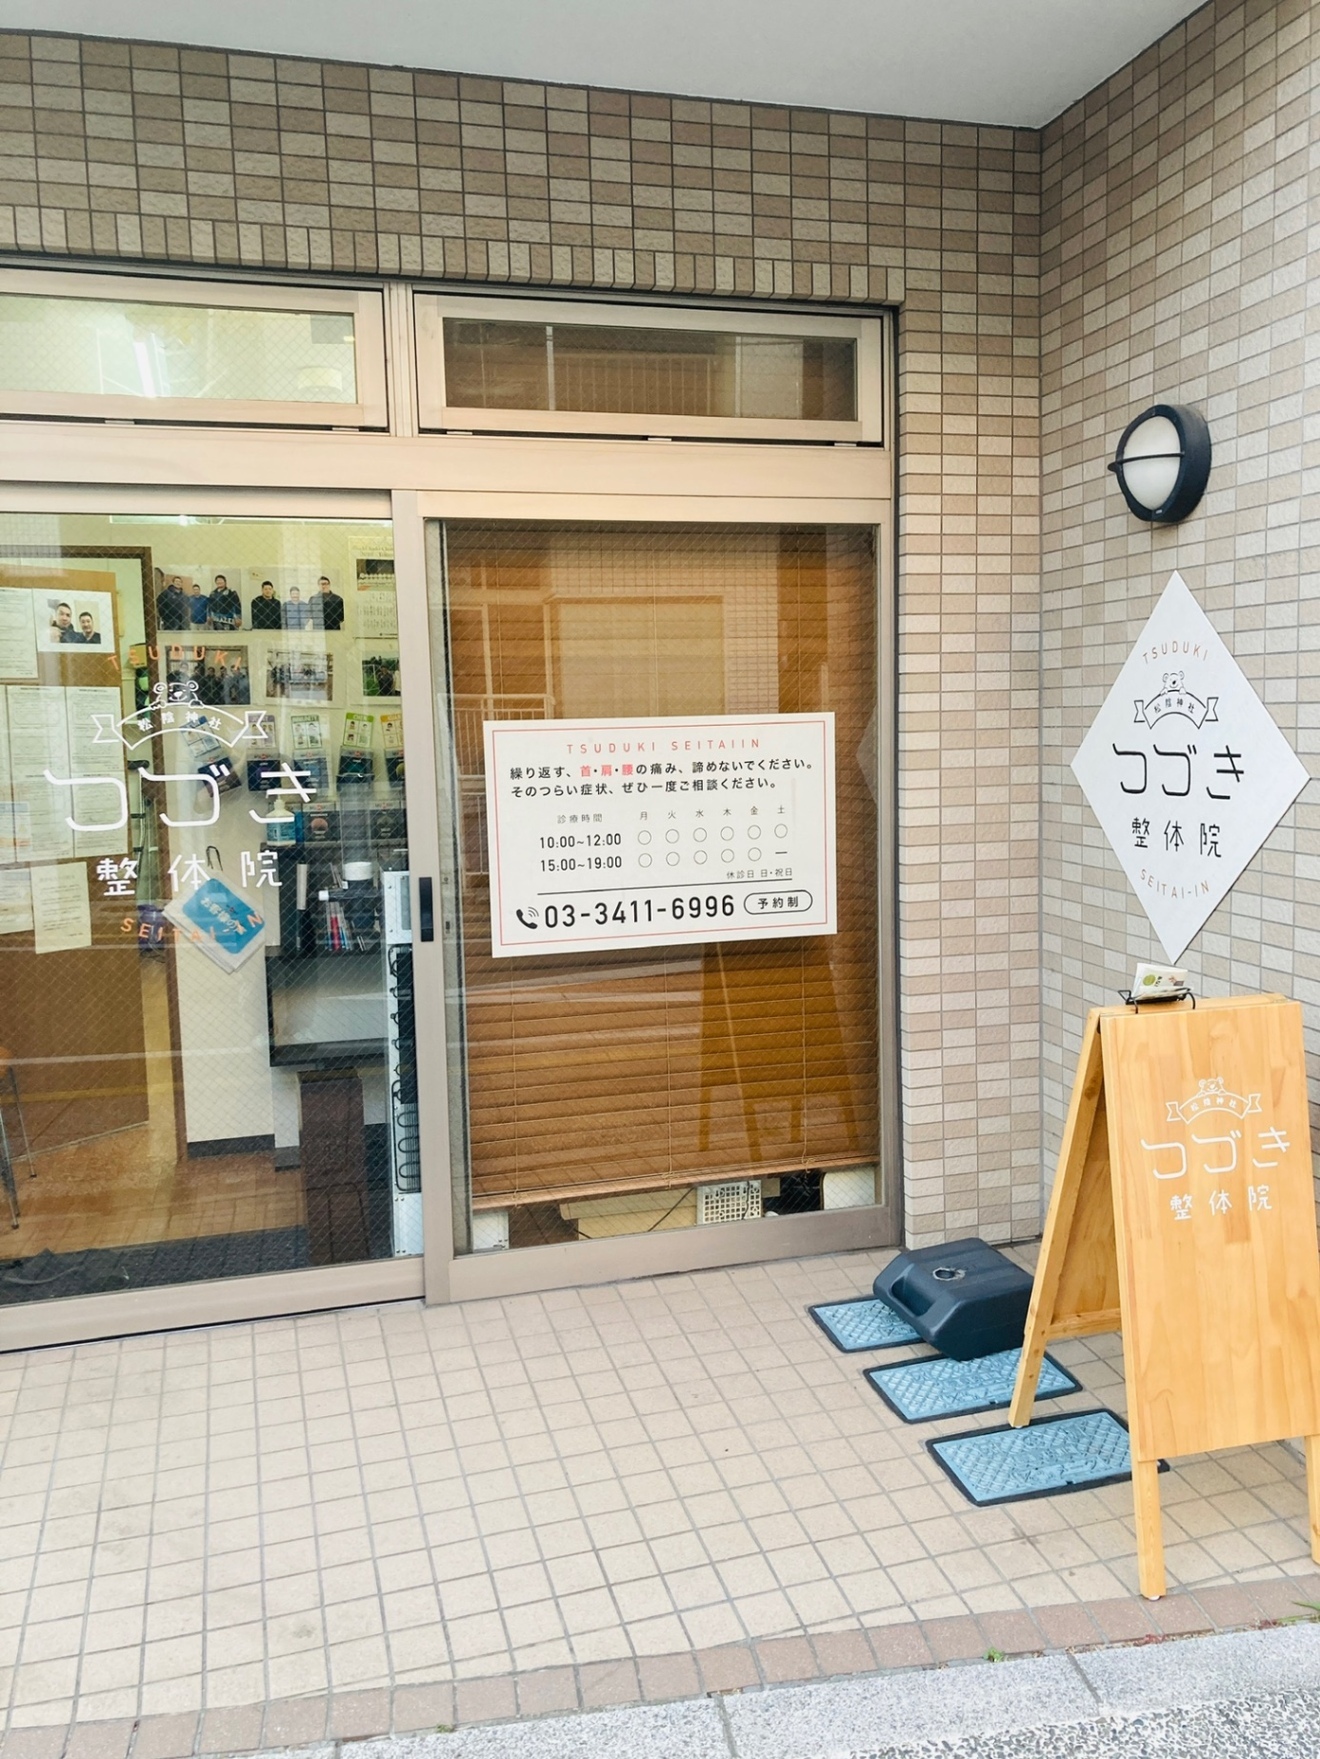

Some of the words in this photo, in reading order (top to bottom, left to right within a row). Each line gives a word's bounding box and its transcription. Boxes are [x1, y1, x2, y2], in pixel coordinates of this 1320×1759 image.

[107, 643, 243, 671] TSUDUKI
[1142, 640, 1209, 665] TSUDUKI
[566, 741, 656, 754] TSUDUKI
[671, 738, 760, 751] SEITAIIN
[510, 778, 778, 798] そのつらい症状、ぜひ一度ご相談ください。
[1112, 743, 1245, 801] つづき
[43, 762, 317, 832] つづき
[557, 813, 603, 825] 診療時間
[639, 811, 648, 821] 月
[667, 810, 677, 820] 火
[695, 809, 705, 819] 水
[723, 807, 732, 817] 木
[750, 805, 759, 816] 金
[777, 805, 786, 815] 土
[1131, 816, 1222, 858] 整体院
[96, 850, 283, 897] 整体院
[1140, 868, 1210, 899] SEITAI-IN
[544, 894, 735, 930] 03-3411-6996
[757, 896, 799, 910] 予約制
[1140, 1126, 1290, 1180] つづき
[1170, 1185, 1273, 1221] 整体院
